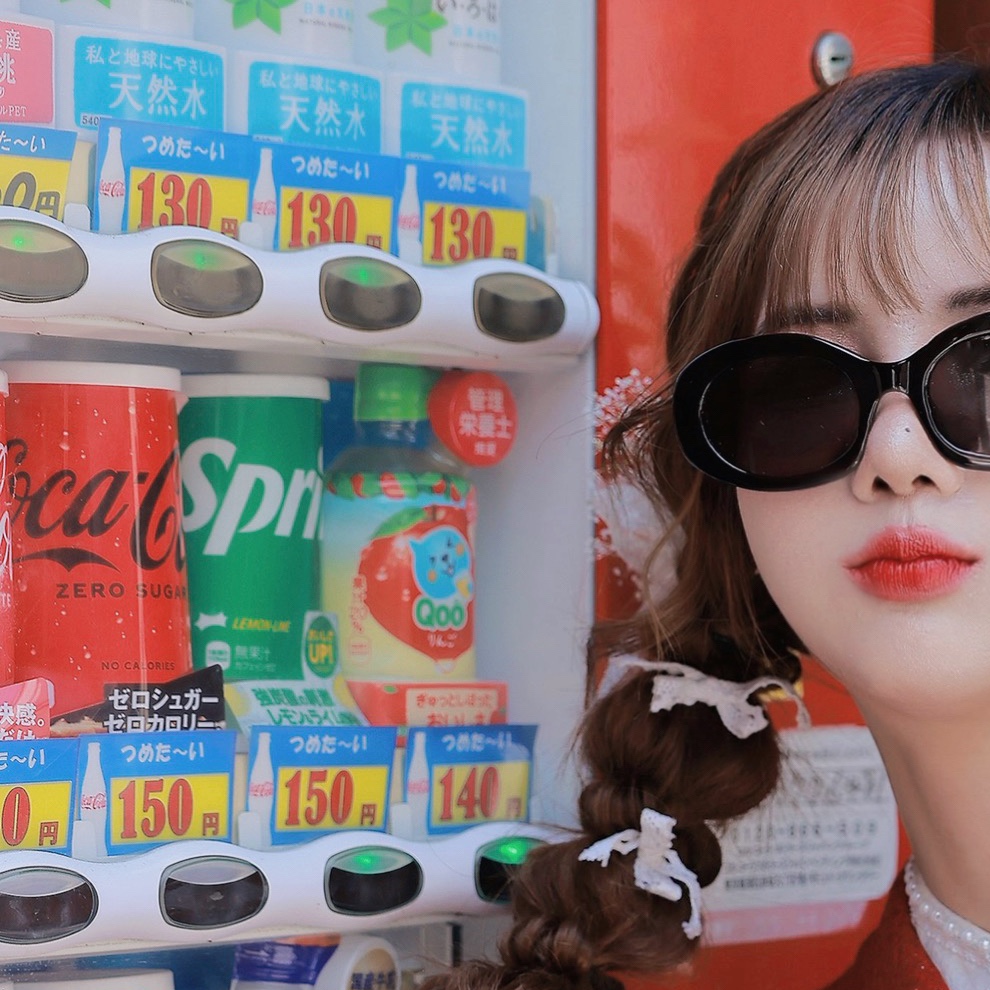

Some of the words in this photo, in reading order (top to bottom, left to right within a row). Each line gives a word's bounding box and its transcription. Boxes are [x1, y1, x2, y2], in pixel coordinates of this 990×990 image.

[0, 28, 21, 51] 産
[85, 44, 220, 77] 私と地球にやさしい
[108, 71, 206, 120] 天然水
[81, 115, 101, 126] 540
[279, 95, 367, 142] 天然水
[431, 113, 513, 159] 天然水
[56, 582, 125, 599] ZERO
[415, 597, 465, 628] Qoo
[102, 662, 119, 671] NO
[124, 660, 176, 671] CALORIES
[308, 643, 334, 665] UP!
[109, 688, 219, 711] ゼロシュガー
